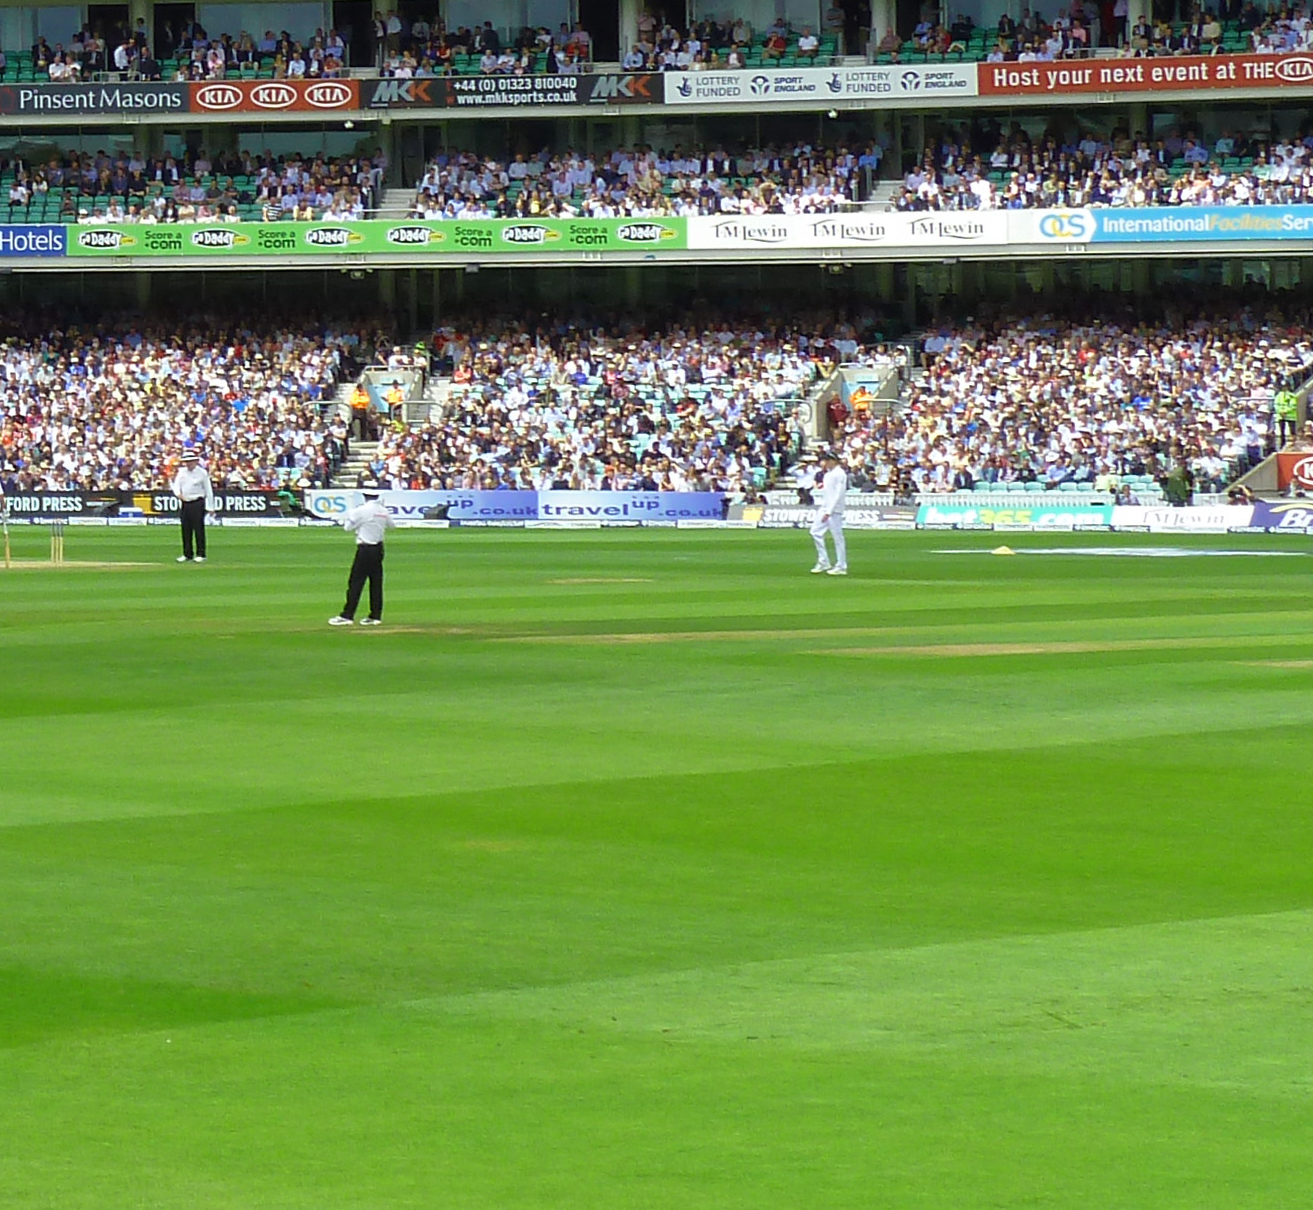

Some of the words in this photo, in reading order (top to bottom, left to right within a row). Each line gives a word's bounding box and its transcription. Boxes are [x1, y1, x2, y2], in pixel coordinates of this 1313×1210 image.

[774, 76, 803, 85] SPORT
[846, 72, 890, 83] LOTTERY
[924, 72, 953, 81] SPORT
[993, 68, 1040, 87] Host
[1047, 68, 1093, 89] your
[1100, 65, 1144, 84] next
[1151, 62, 1209, 82] event
[1216, 61, 1236, 80] at
[1242, 61, 1275, 78] THE
[454, 79, 475, 92] +44
[478, 78, 496, 92] (0)
[499, 78, 531, 91] 01323
[534, 77, 577, 89] 810040
[696, 76, 740, 87] LOTTERY
[924, 80, 966, 89] ENGLAND
[313, 86, 344, 102] KIA
[696, 87, 741, 98] FUNDED
[774, 84, 816, 93] ENGLAND
[846, 83, 891, 94] FUNDED
[20, 89, 95, 109] Pinsent
[100, 89, 181, 108] Masons
[205, 88, 235, 104] KIA
[258, 87, 290, 102] KIA
[457, 90, 577, 105] www.mkksports.co.uk
[570, 225, 597, 234] Score
[1040, 213, 1086, 237] OCS
[1102, 214, 1210, 233] International
[145, 230, 173, 239] Score
[258, 230, 286, 238] Score
[455, 227, 483, 236] Score
[0, 230, 63, 251] Hotels
[145, 240, 182, 250] .com
[258, 238, 296, 249] .com
[454, 236, 492, 247] .com
[570, 235, 608, 245] .com
[42, 496, 83, 512] PRESS
[226, 496, 266, 511] PRESS
[314, 496, 348, 514] OCS
[764, 509, 818, 523] STOWFO
